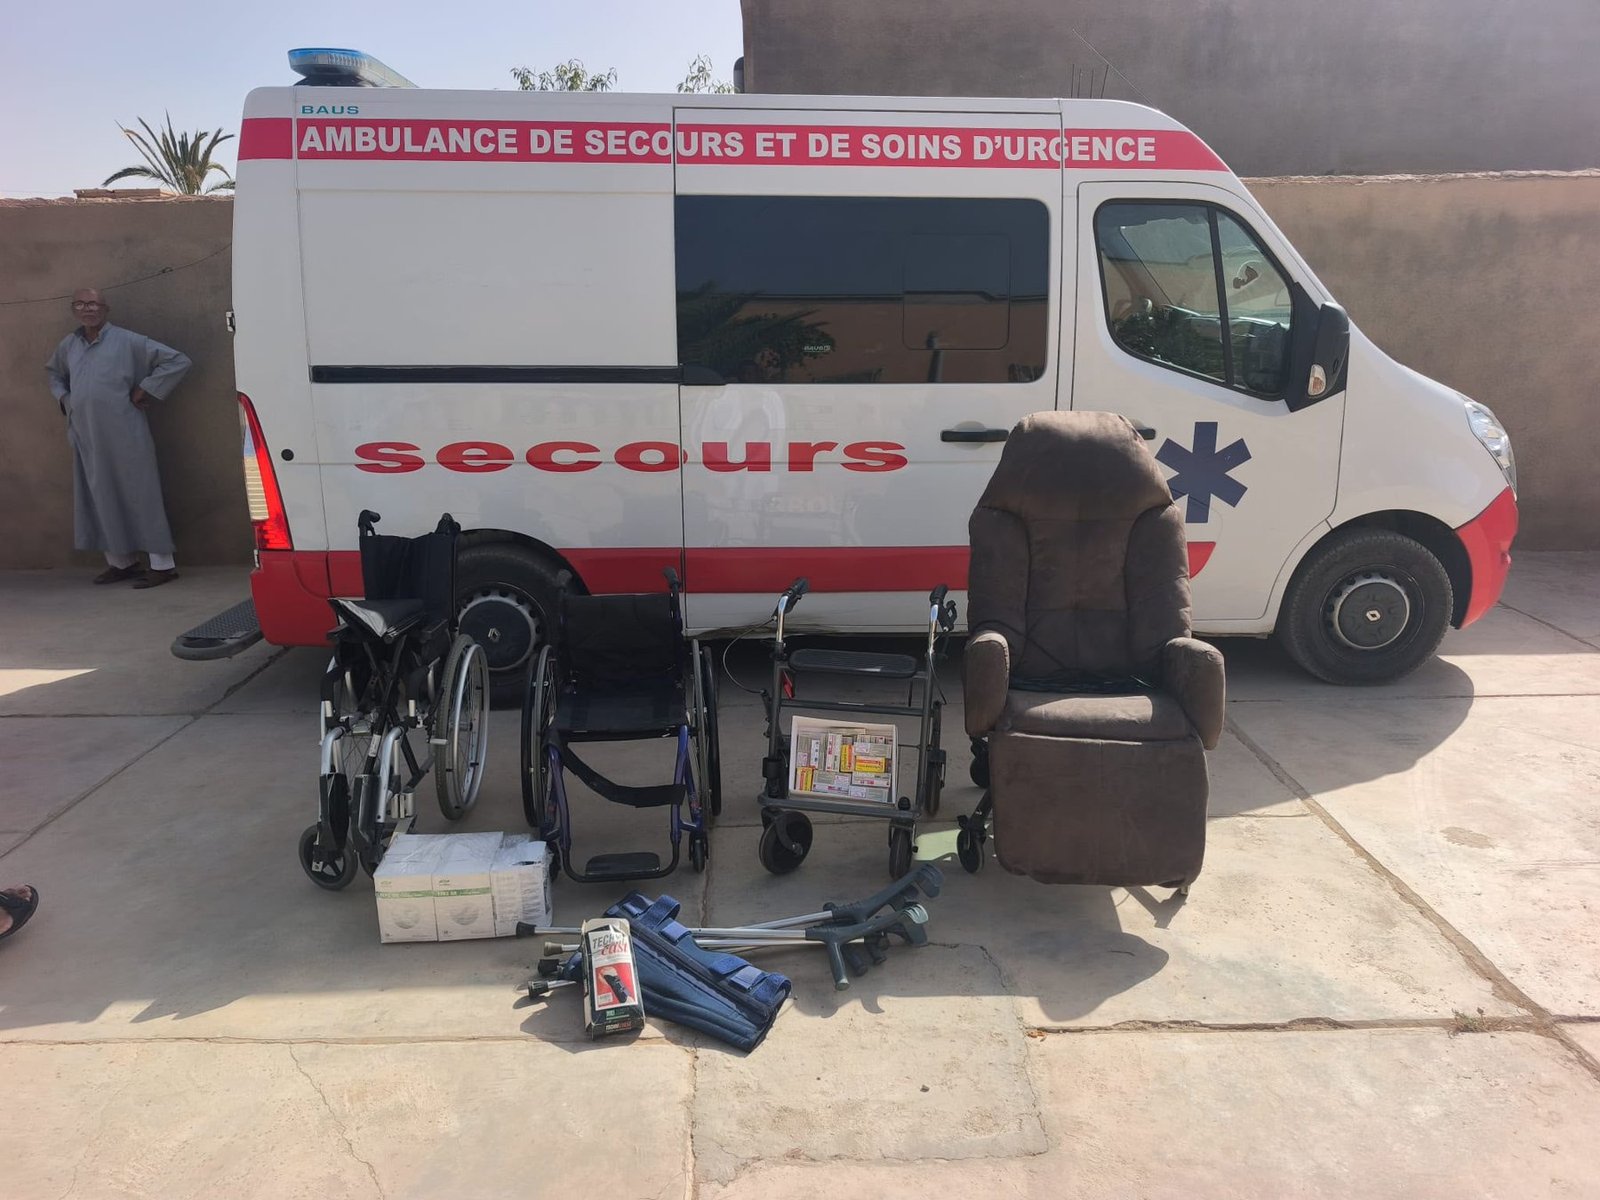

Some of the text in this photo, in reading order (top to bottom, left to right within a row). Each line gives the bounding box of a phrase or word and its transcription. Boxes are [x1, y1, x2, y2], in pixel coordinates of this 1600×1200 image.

[301, 105, 359, 115] BAUS
[300, 125, 1156, 162] AMBULANCE DE SECOURS ET DE SOINS D'URGENCE
[354, 440, 908, 474] secours
